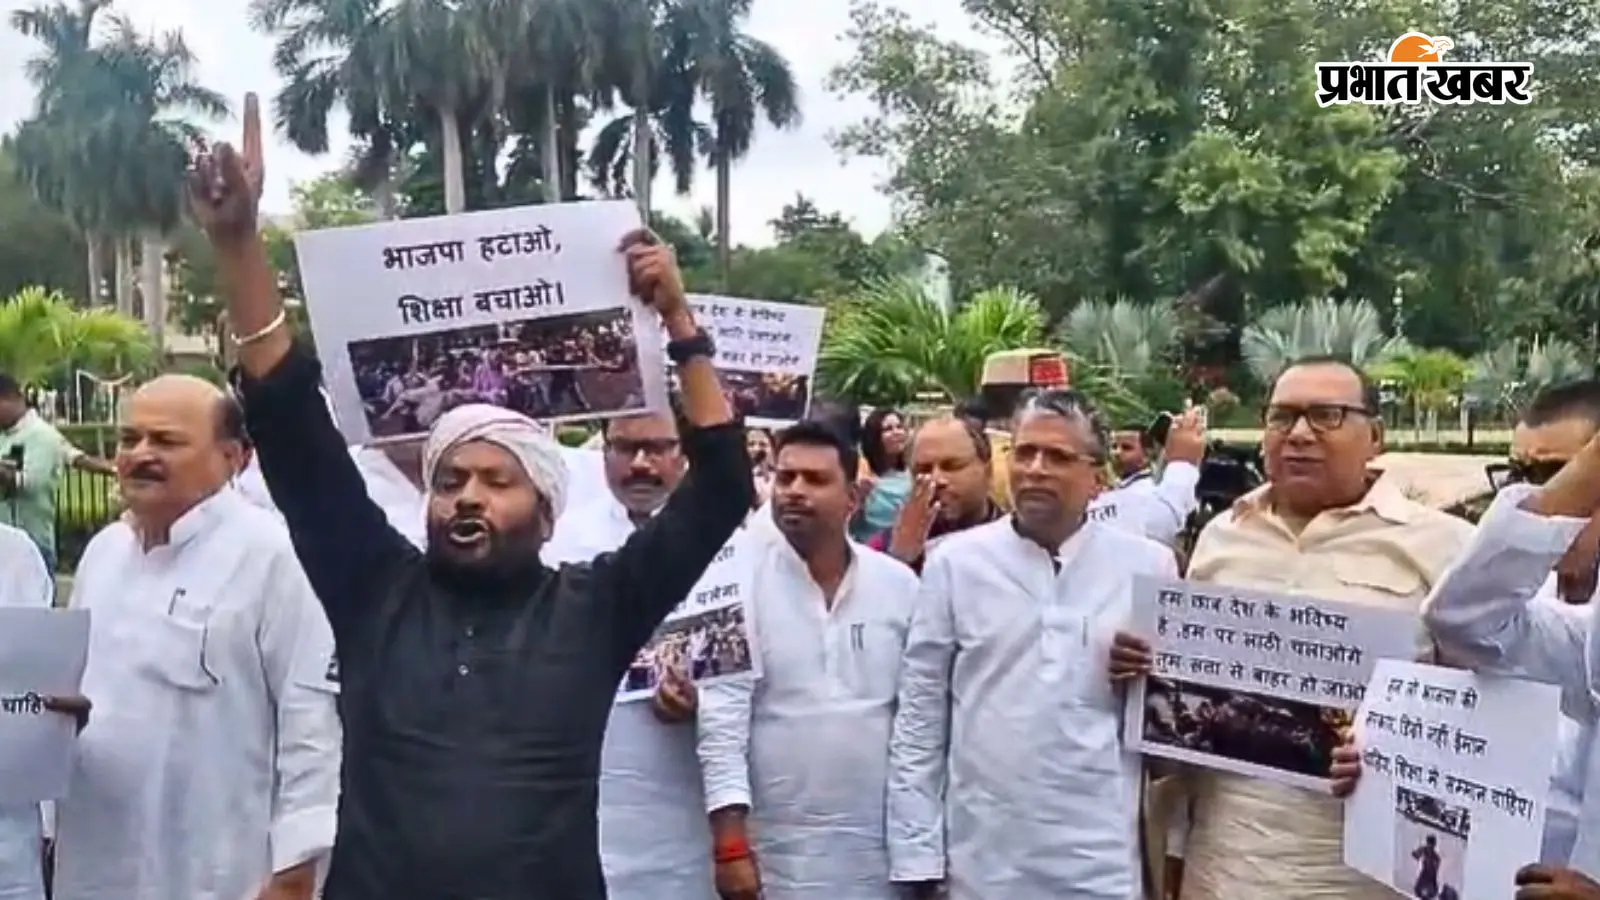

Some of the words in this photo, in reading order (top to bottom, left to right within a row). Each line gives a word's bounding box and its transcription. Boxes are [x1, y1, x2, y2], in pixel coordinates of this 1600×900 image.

[383, 239, 464, 270] भाजपा
[477, 224, 562, 261] हटाओ,
[398, 294, 463, 324] शिक्षा
[473, 278, 565, 313] बचाओ।
[1157, 590, 1183, 607] हम
[1229, 597, 1256, 618] देश
[1263, 600, 1281, 619] के
[1290, 605, 1349, 632] भविष्य
[1213, 628, 1234, 645] पर
[1243, 631, 1282, 652] लाठी
[1290, 639, 1363, 665] चलाओगे
[1156, 652, 1183, 674] तुम
[1229, 660, 1244, 680] से
[1252, 667, 1292, 689] बाहर
[1300, 672, 1318, 693] हो
[1, 691, 46, 714] चाहि
